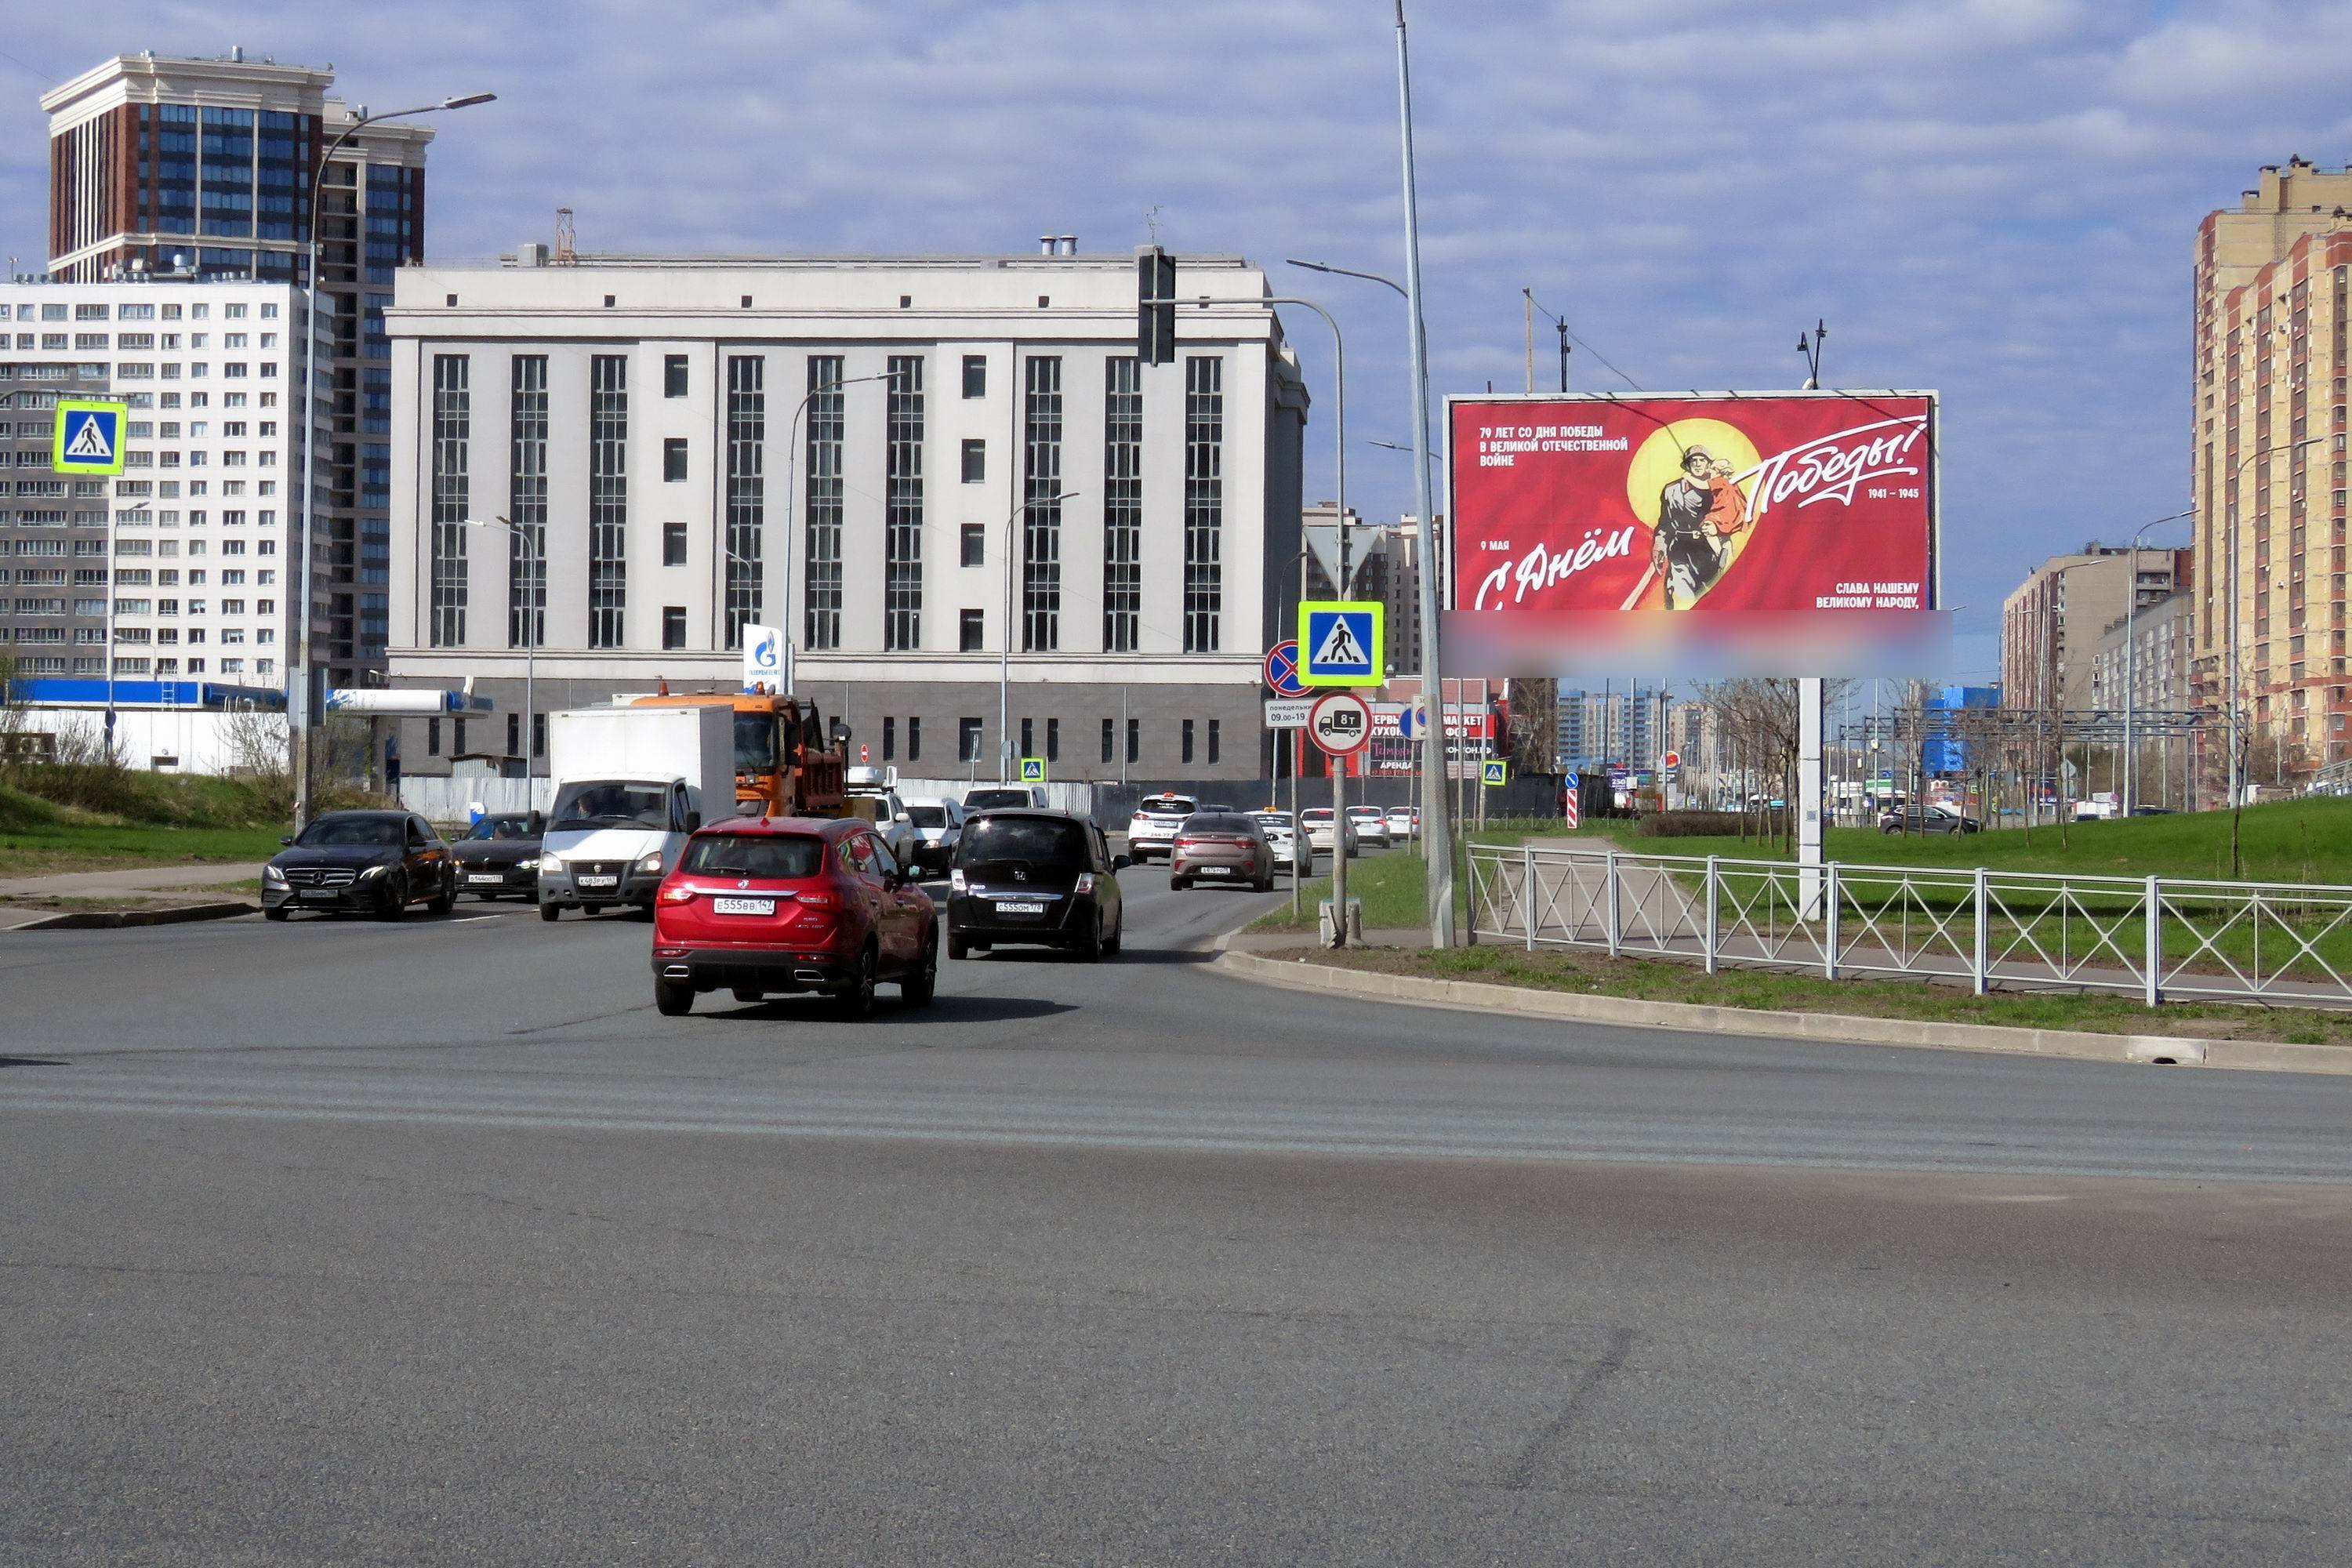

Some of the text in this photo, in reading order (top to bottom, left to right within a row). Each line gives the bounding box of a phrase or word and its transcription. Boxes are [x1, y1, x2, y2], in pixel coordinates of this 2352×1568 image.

[1479, 426, 1603, 439] 79 ЛЕТ СО ДНЯ ПОБЕДЫ
[1479, 437, 1628, 452] В ВЕЛИКОЙ ОТЕЧЕСТВЕННОЙ
[1479, 452, 1515, 466] ВОЙНЕ
[1729, 414, 1928, 522] Победы!
[1868, 488, 1887, 499] 1941
[1898, 488, 1919, 499] 1945
[1480, 540, 1510, 550] 9 МАЯ
[1515, 526, 1635, 603] Днём
[1836, 583, 1919, 594] СЛАВА НАШЕМУ
[1817, 597, 1919, 610] ВЕЛИКОМУ НАРОДУ,
[1271, 713, 1308, 721] 09.00-19.
